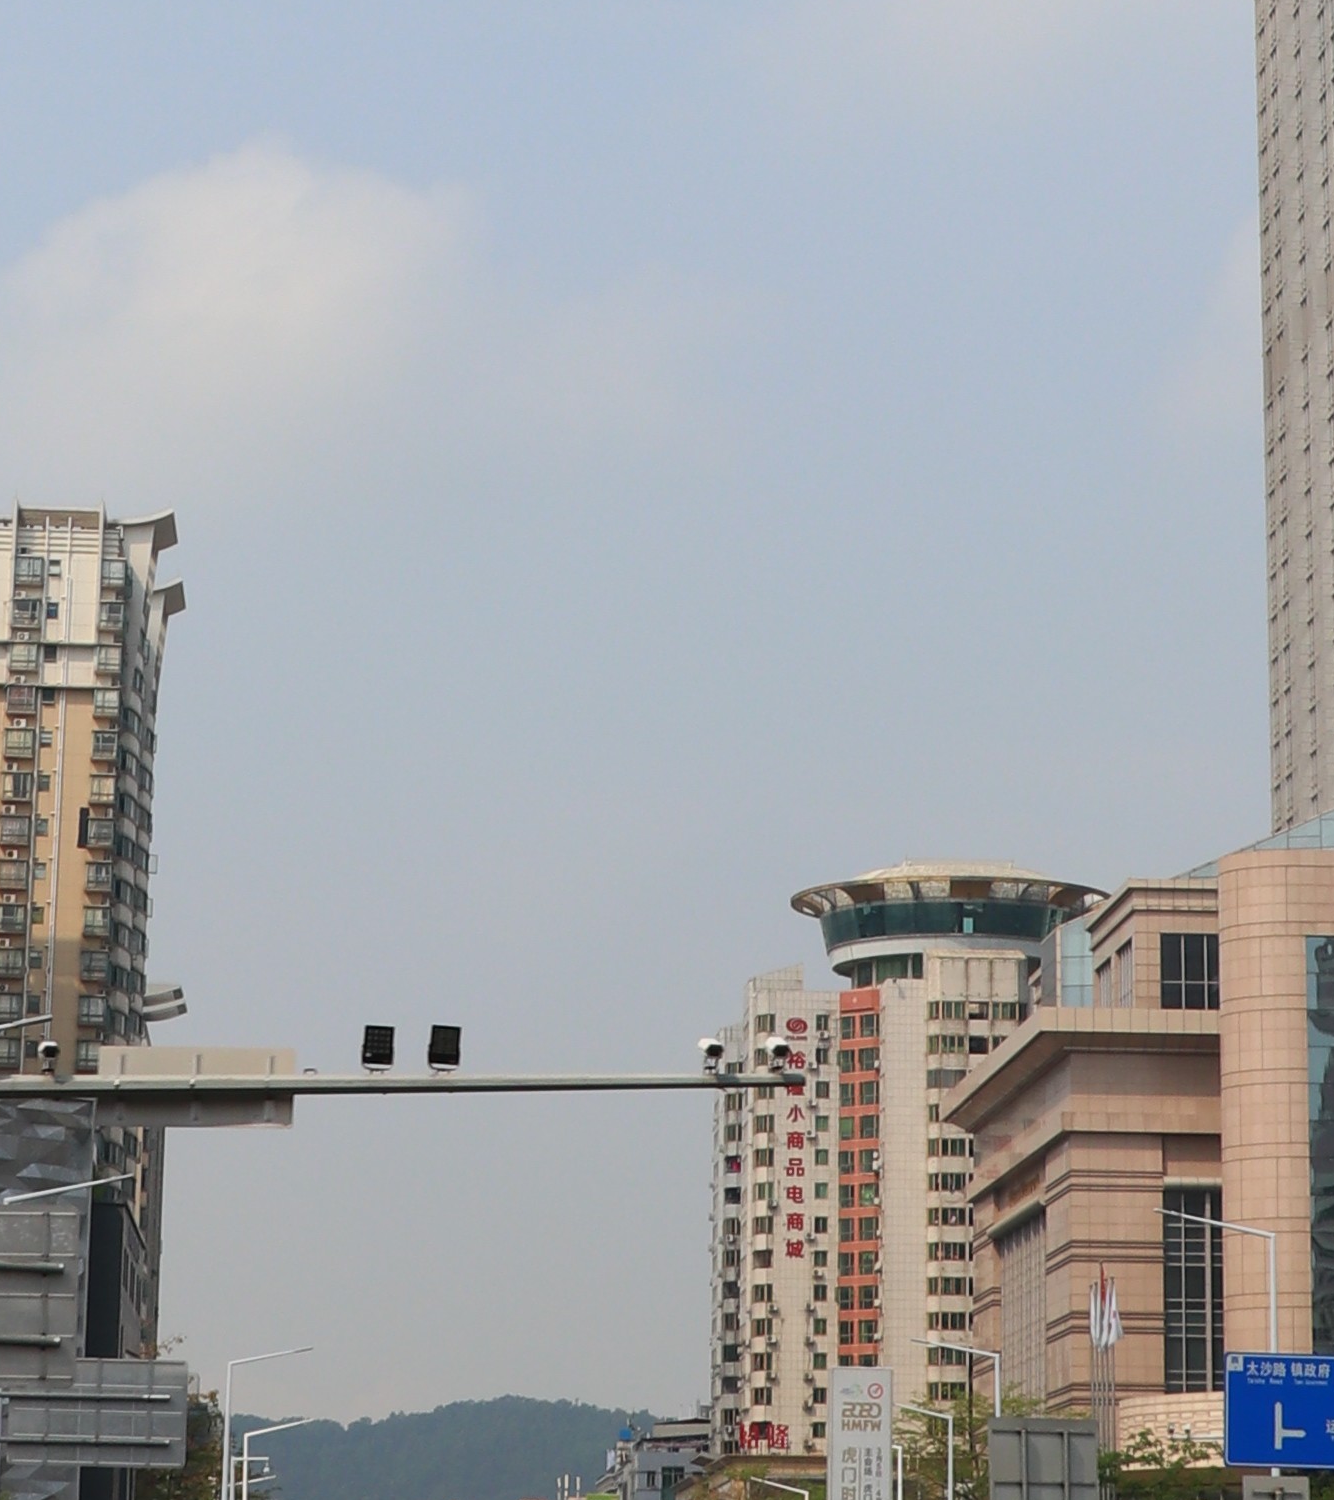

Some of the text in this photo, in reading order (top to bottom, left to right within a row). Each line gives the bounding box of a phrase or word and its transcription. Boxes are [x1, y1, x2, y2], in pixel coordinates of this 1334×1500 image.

[1291, 1362, 1331, 1379] 镇政府
[841, 1418, 882, 1432] HMFW
